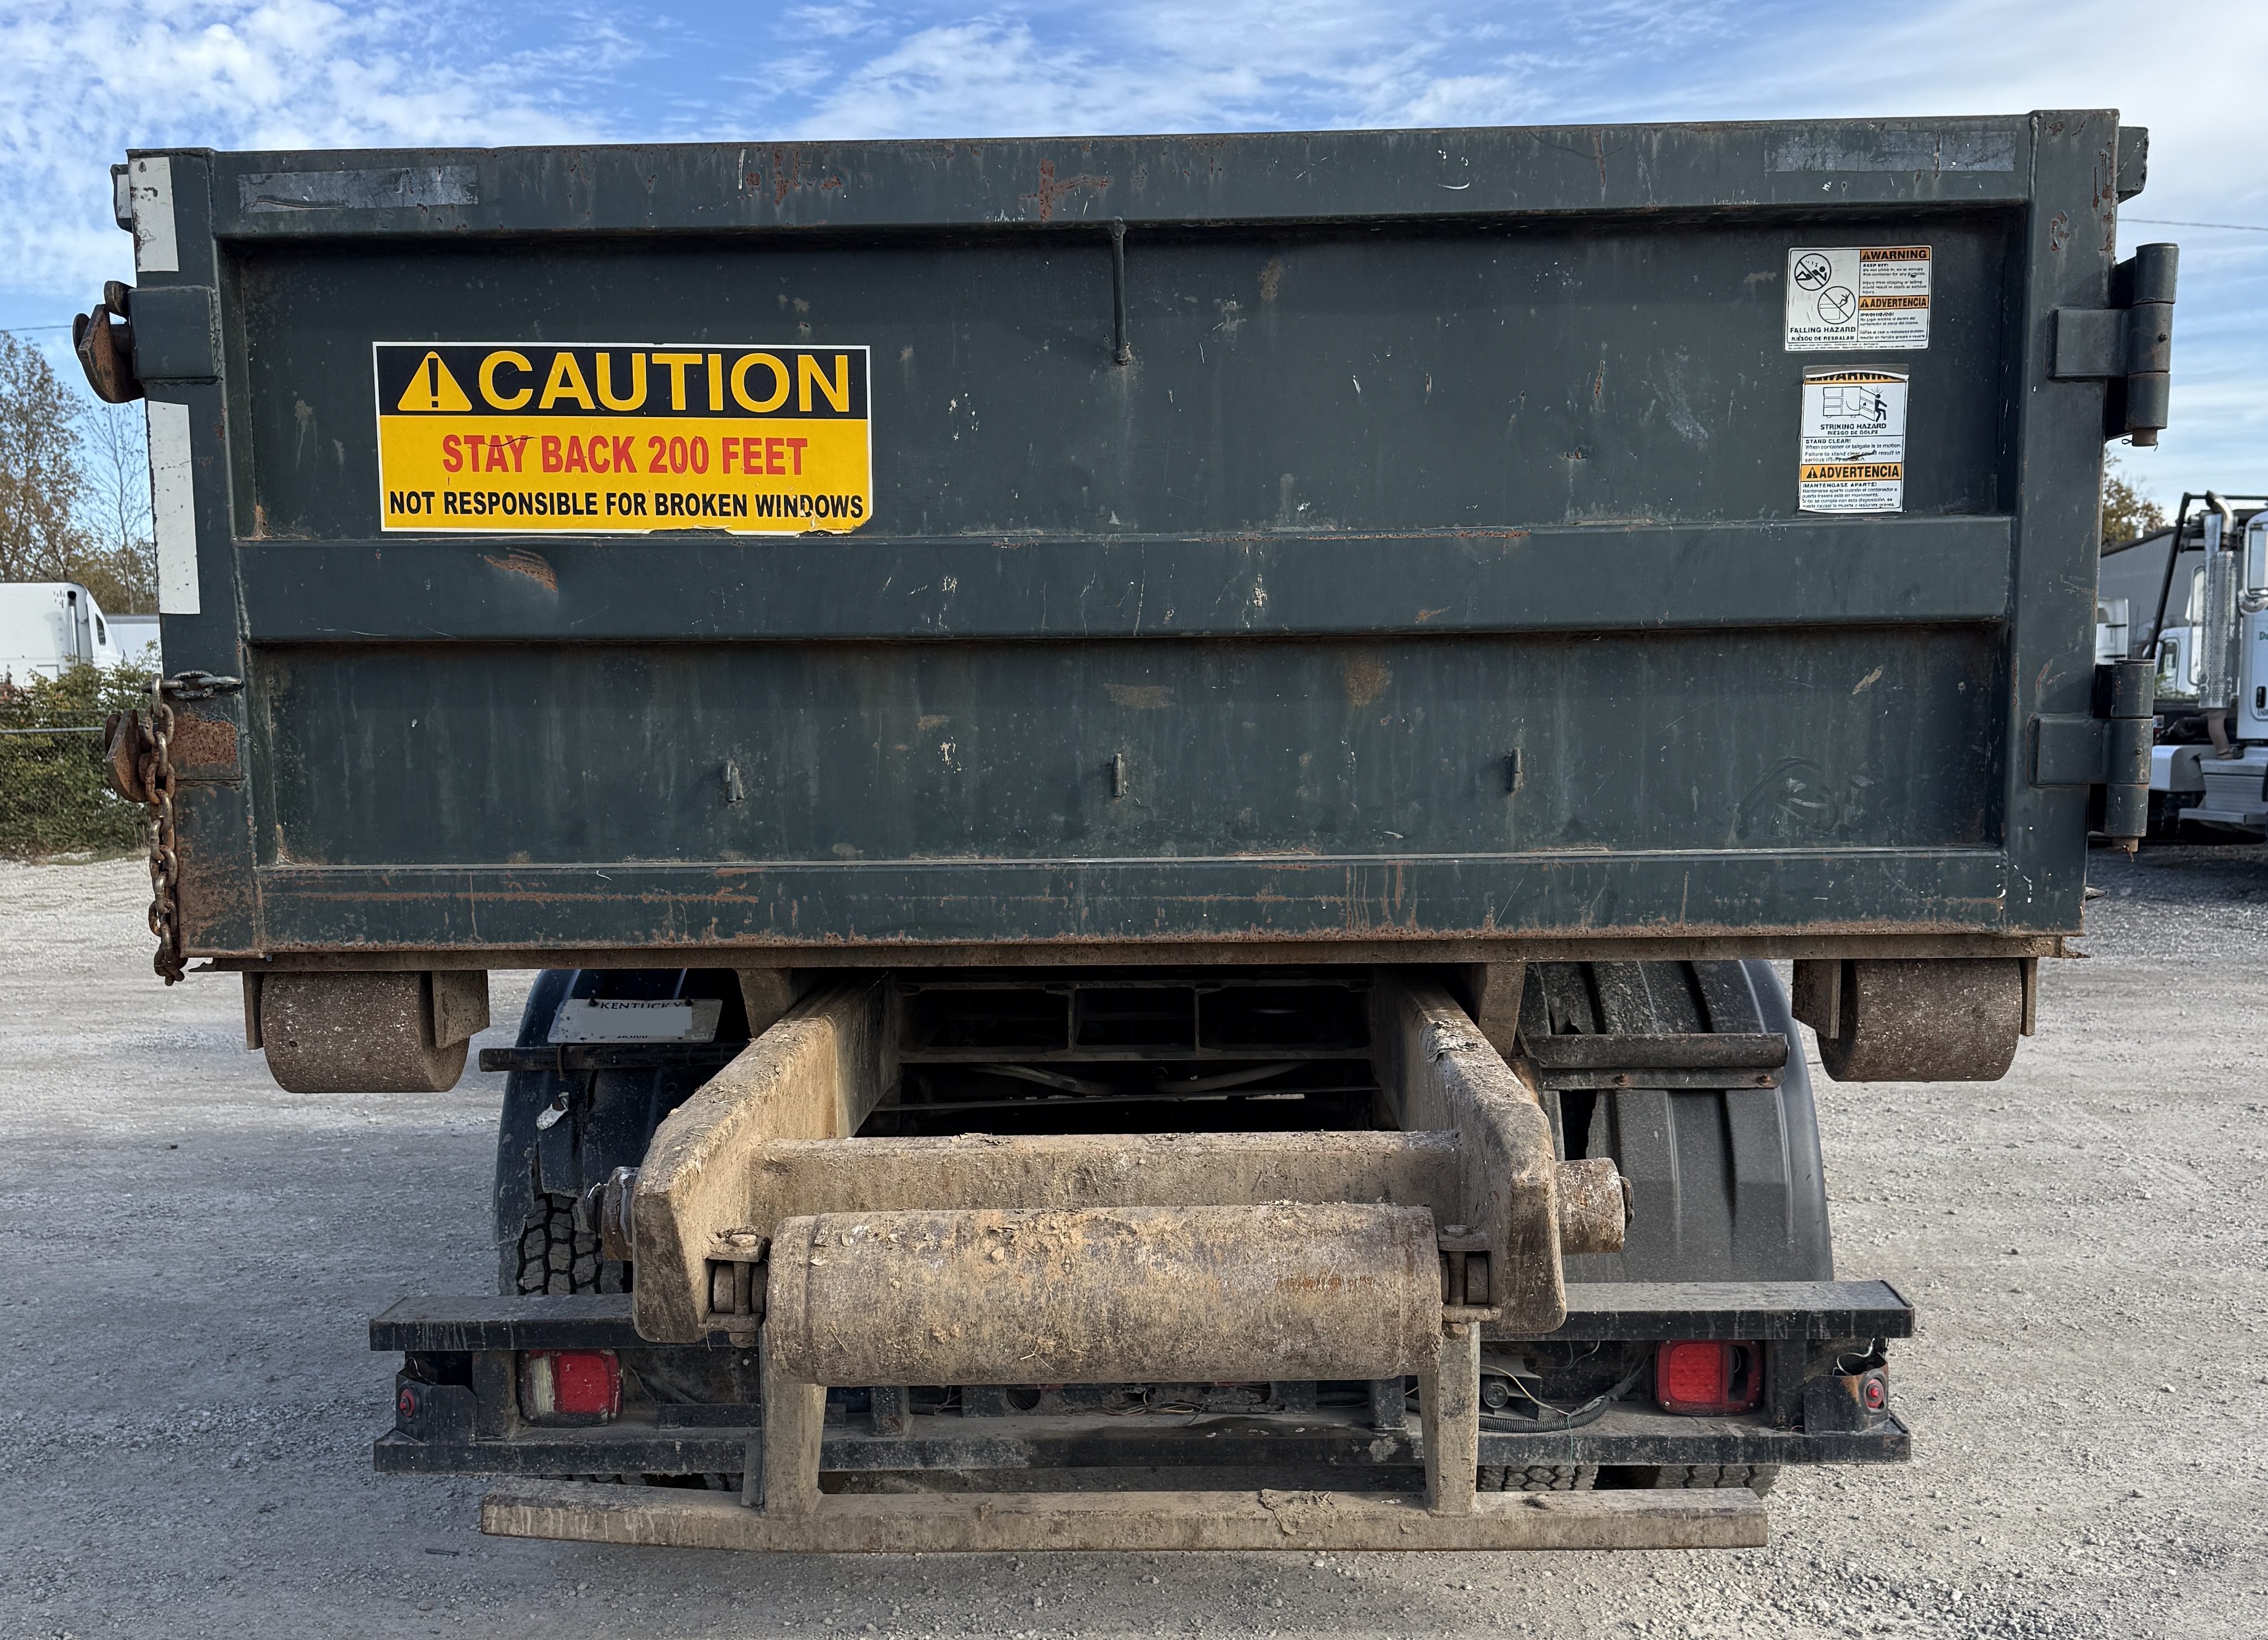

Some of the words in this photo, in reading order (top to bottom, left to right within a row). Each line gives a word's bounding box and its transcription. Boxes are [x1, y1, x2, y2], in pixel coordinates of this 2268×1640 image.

[1871, 250, 1926, 260] WARNING
[1870, 298, 1926, 308] ADVERTENCIA
[478, 350, 850, 413] CAUTION
[442, 434, 529, 474] STAY
[540, 435, 637, 474] BACK
[648, 436, 710, 475] 200
[722, 437, 809, 476] FEET
[1819, 465, 1899, 478] ADVERTENCIA
[389, 491, 436, 515] NOT
[444, 491, 598, 516] RESPONSIBLE
[605, 492, 648, 517] FOR
[654, 493, 748, 518] BROKEN
[754, 493, 864, 519] WINDOWS
